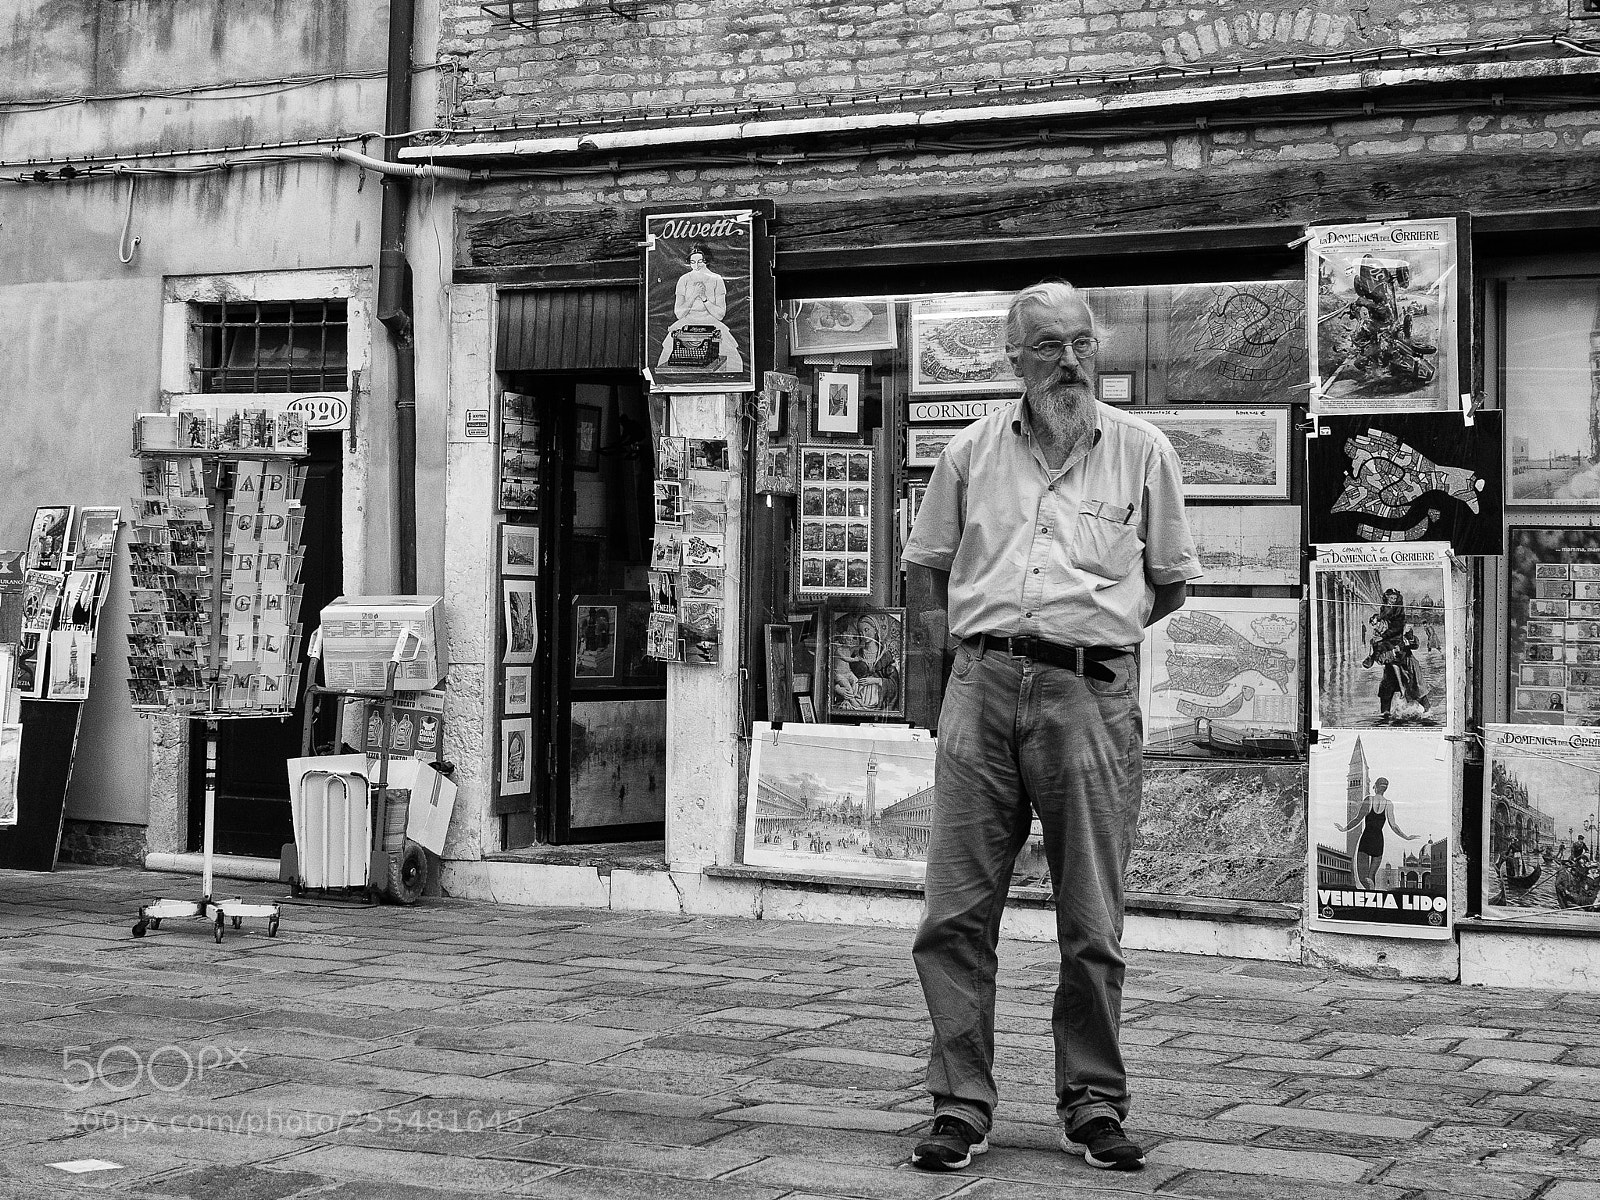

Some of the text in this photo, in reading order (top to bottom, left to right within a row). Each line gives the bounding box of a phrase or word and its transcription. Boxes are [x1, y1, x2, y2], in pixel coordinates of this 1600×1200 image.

[655, 219, 743, 239] Olivetti
[1327, 231, 1380, 245] DOMENICA
[1391, 228, 1440, 244] CORRIERE
[916, 403, 988, 419] CORNICI
[240, 475, 255, 492] A
[271, 475, 283, 491] B
[1332, 552, 1377, 564] DOMENICA
[1390, 551, 1435, 565] CORRIERE
[1504, 732, 1558, 746] DOMENICA
[1318, 889, 1447, 912] VENEZIA LIDO
